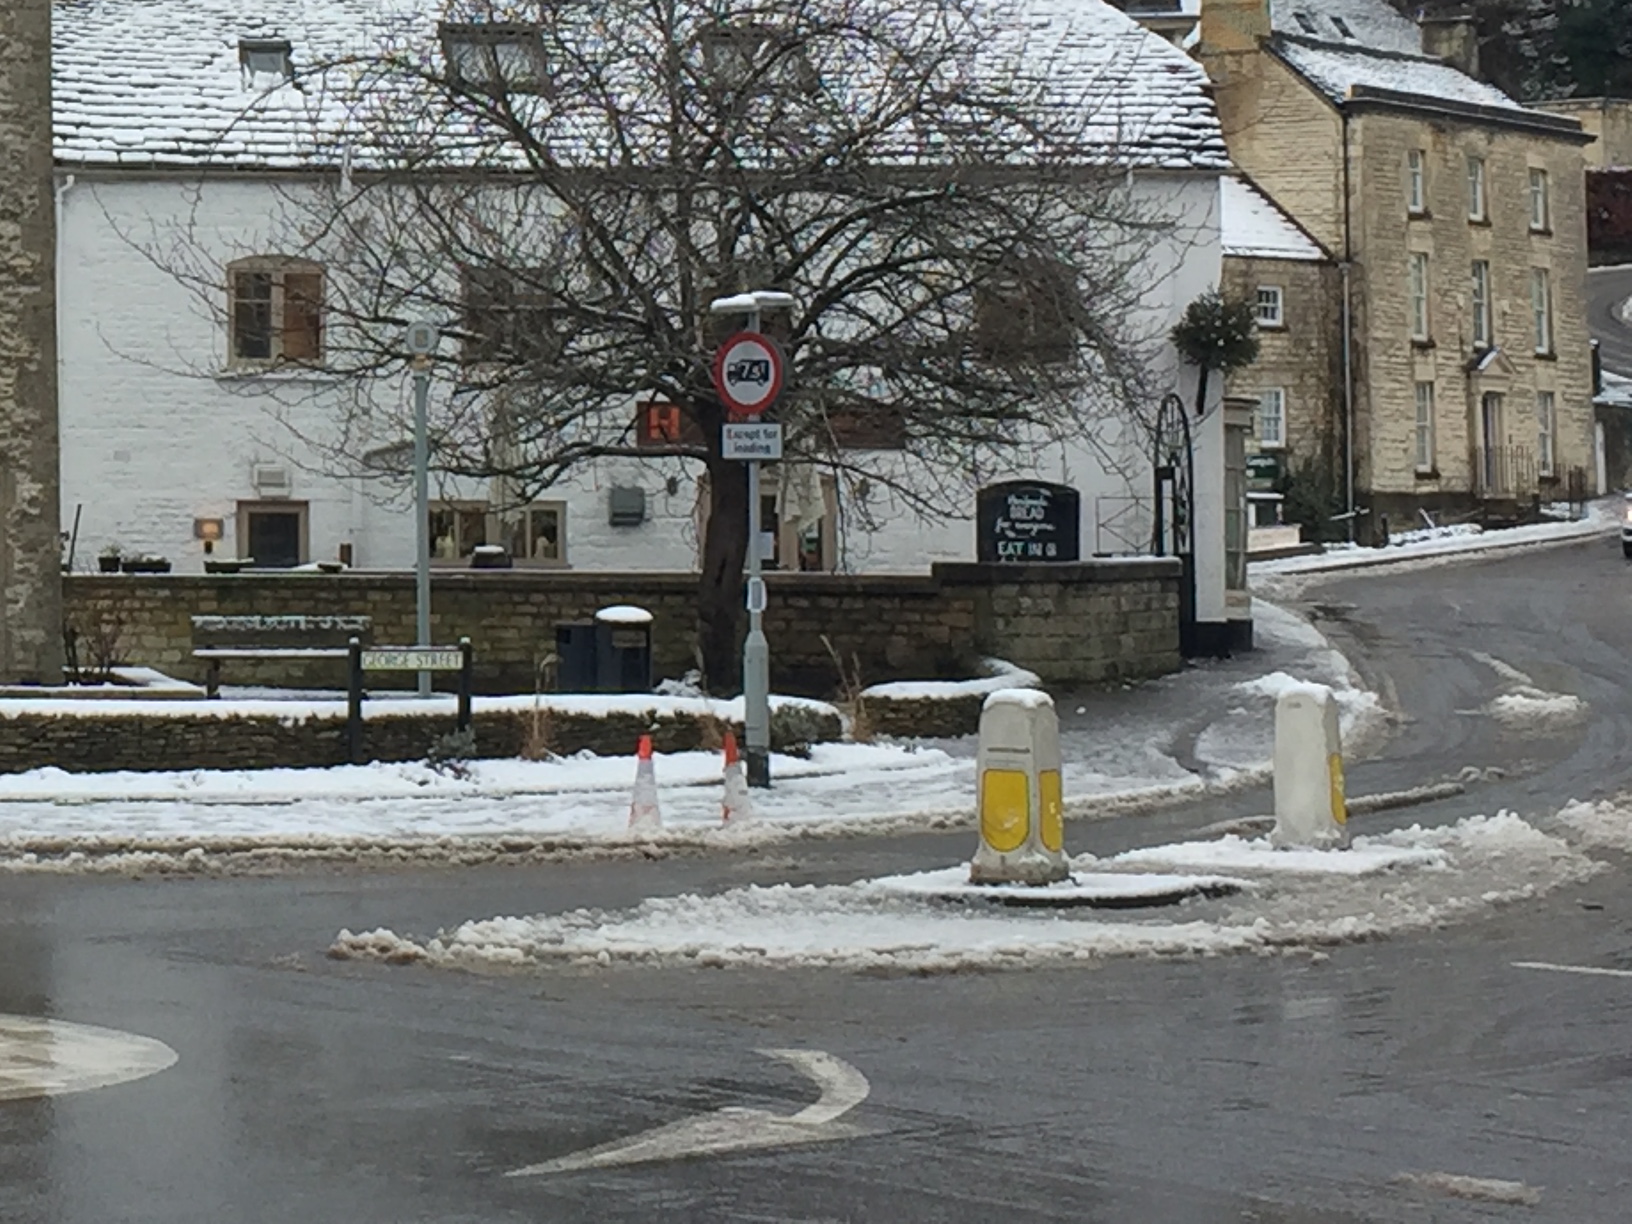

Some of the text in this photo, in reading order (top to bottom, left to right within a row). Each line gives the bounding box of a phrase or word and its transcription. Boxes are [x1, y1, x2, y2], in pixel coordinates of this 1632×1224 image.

[726, 427, 778, 441] Except for
[734, 441, 772, 455] loading
[997, 541, 1025, 555] EAT
[1027, 542, 1043, 557] IN
[363, 652, 461, 666] GEORGE STREET
